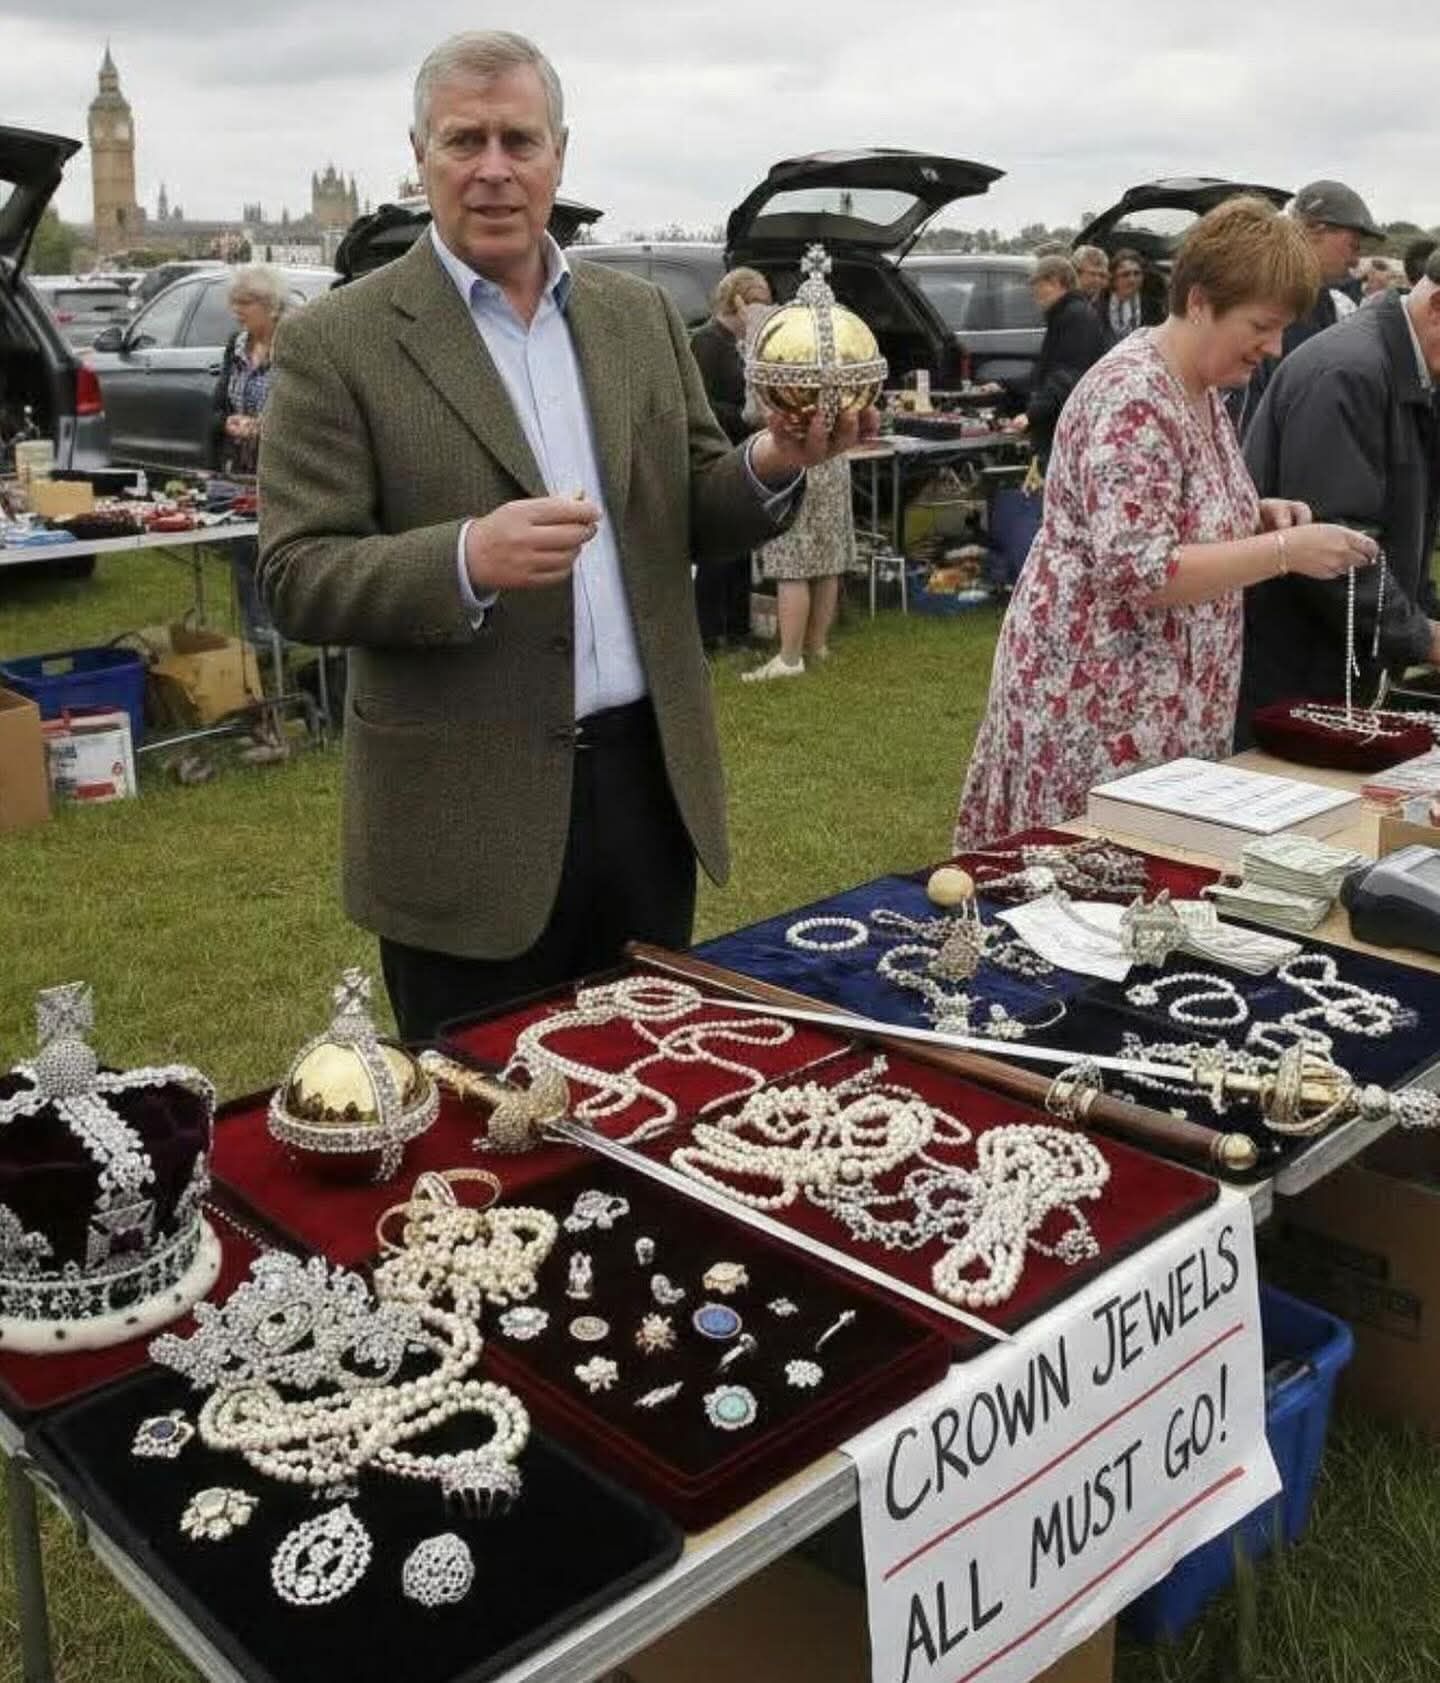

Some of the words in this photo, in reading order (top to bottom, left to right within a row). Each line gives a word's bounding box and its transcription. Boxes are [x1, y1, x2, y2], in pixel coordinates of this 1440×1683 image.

[884, 1335, 1070, 1520] CROWN
[1092, 1225, 1239, 1386] JEWELS
[902, 1559, 1003, 1683] ALL
[1029, 1439, 1142, 1589] MUST
[1164, 1363, 1227, 1479] GO!
